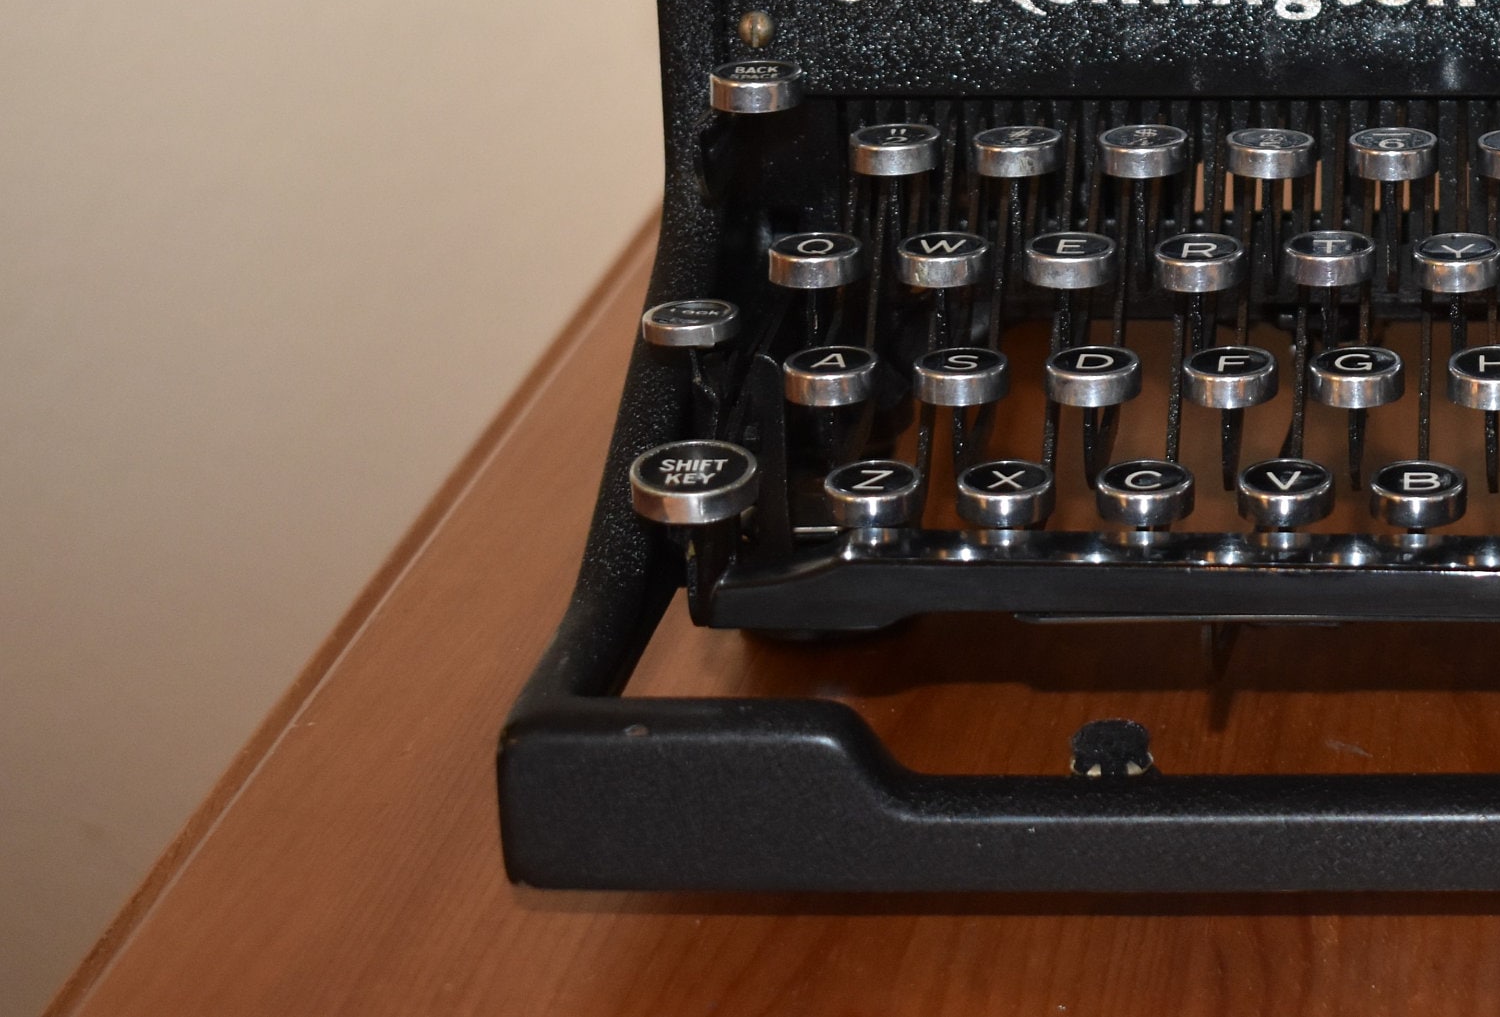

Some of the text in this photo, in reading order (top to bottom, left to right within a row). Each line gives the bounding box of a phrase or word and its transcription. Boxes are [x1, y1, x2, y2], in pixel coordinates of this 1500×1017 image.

[735, 65, 779, 75] BACK
[797, 238, 835, 256] Q
[920, 239, 967, 253] W
[1056, 238, 1087, 255] E
[1181, 242, 1217, 258] R
[1312, 239, 1347, 255] T
[1441, 243, 1476, 260] Y
[811, 353, 846, 369] A
[945, 355, 981, 370] S
[1075, 353, 1115, 370] D
[1217, 356, 1250, 372] F
[1334, 354, 1373, 371] G
[660, 458, 730, 473] SHIFT
[665, 472, 717, 486] KEY
[852, 470, 894, 490] Z
[988, 470, 1026, 490] X
[1124, 470, 1163, 490] C
[1266, 470, 1302, 491] V
[1402, 471, 1441, 492] B
